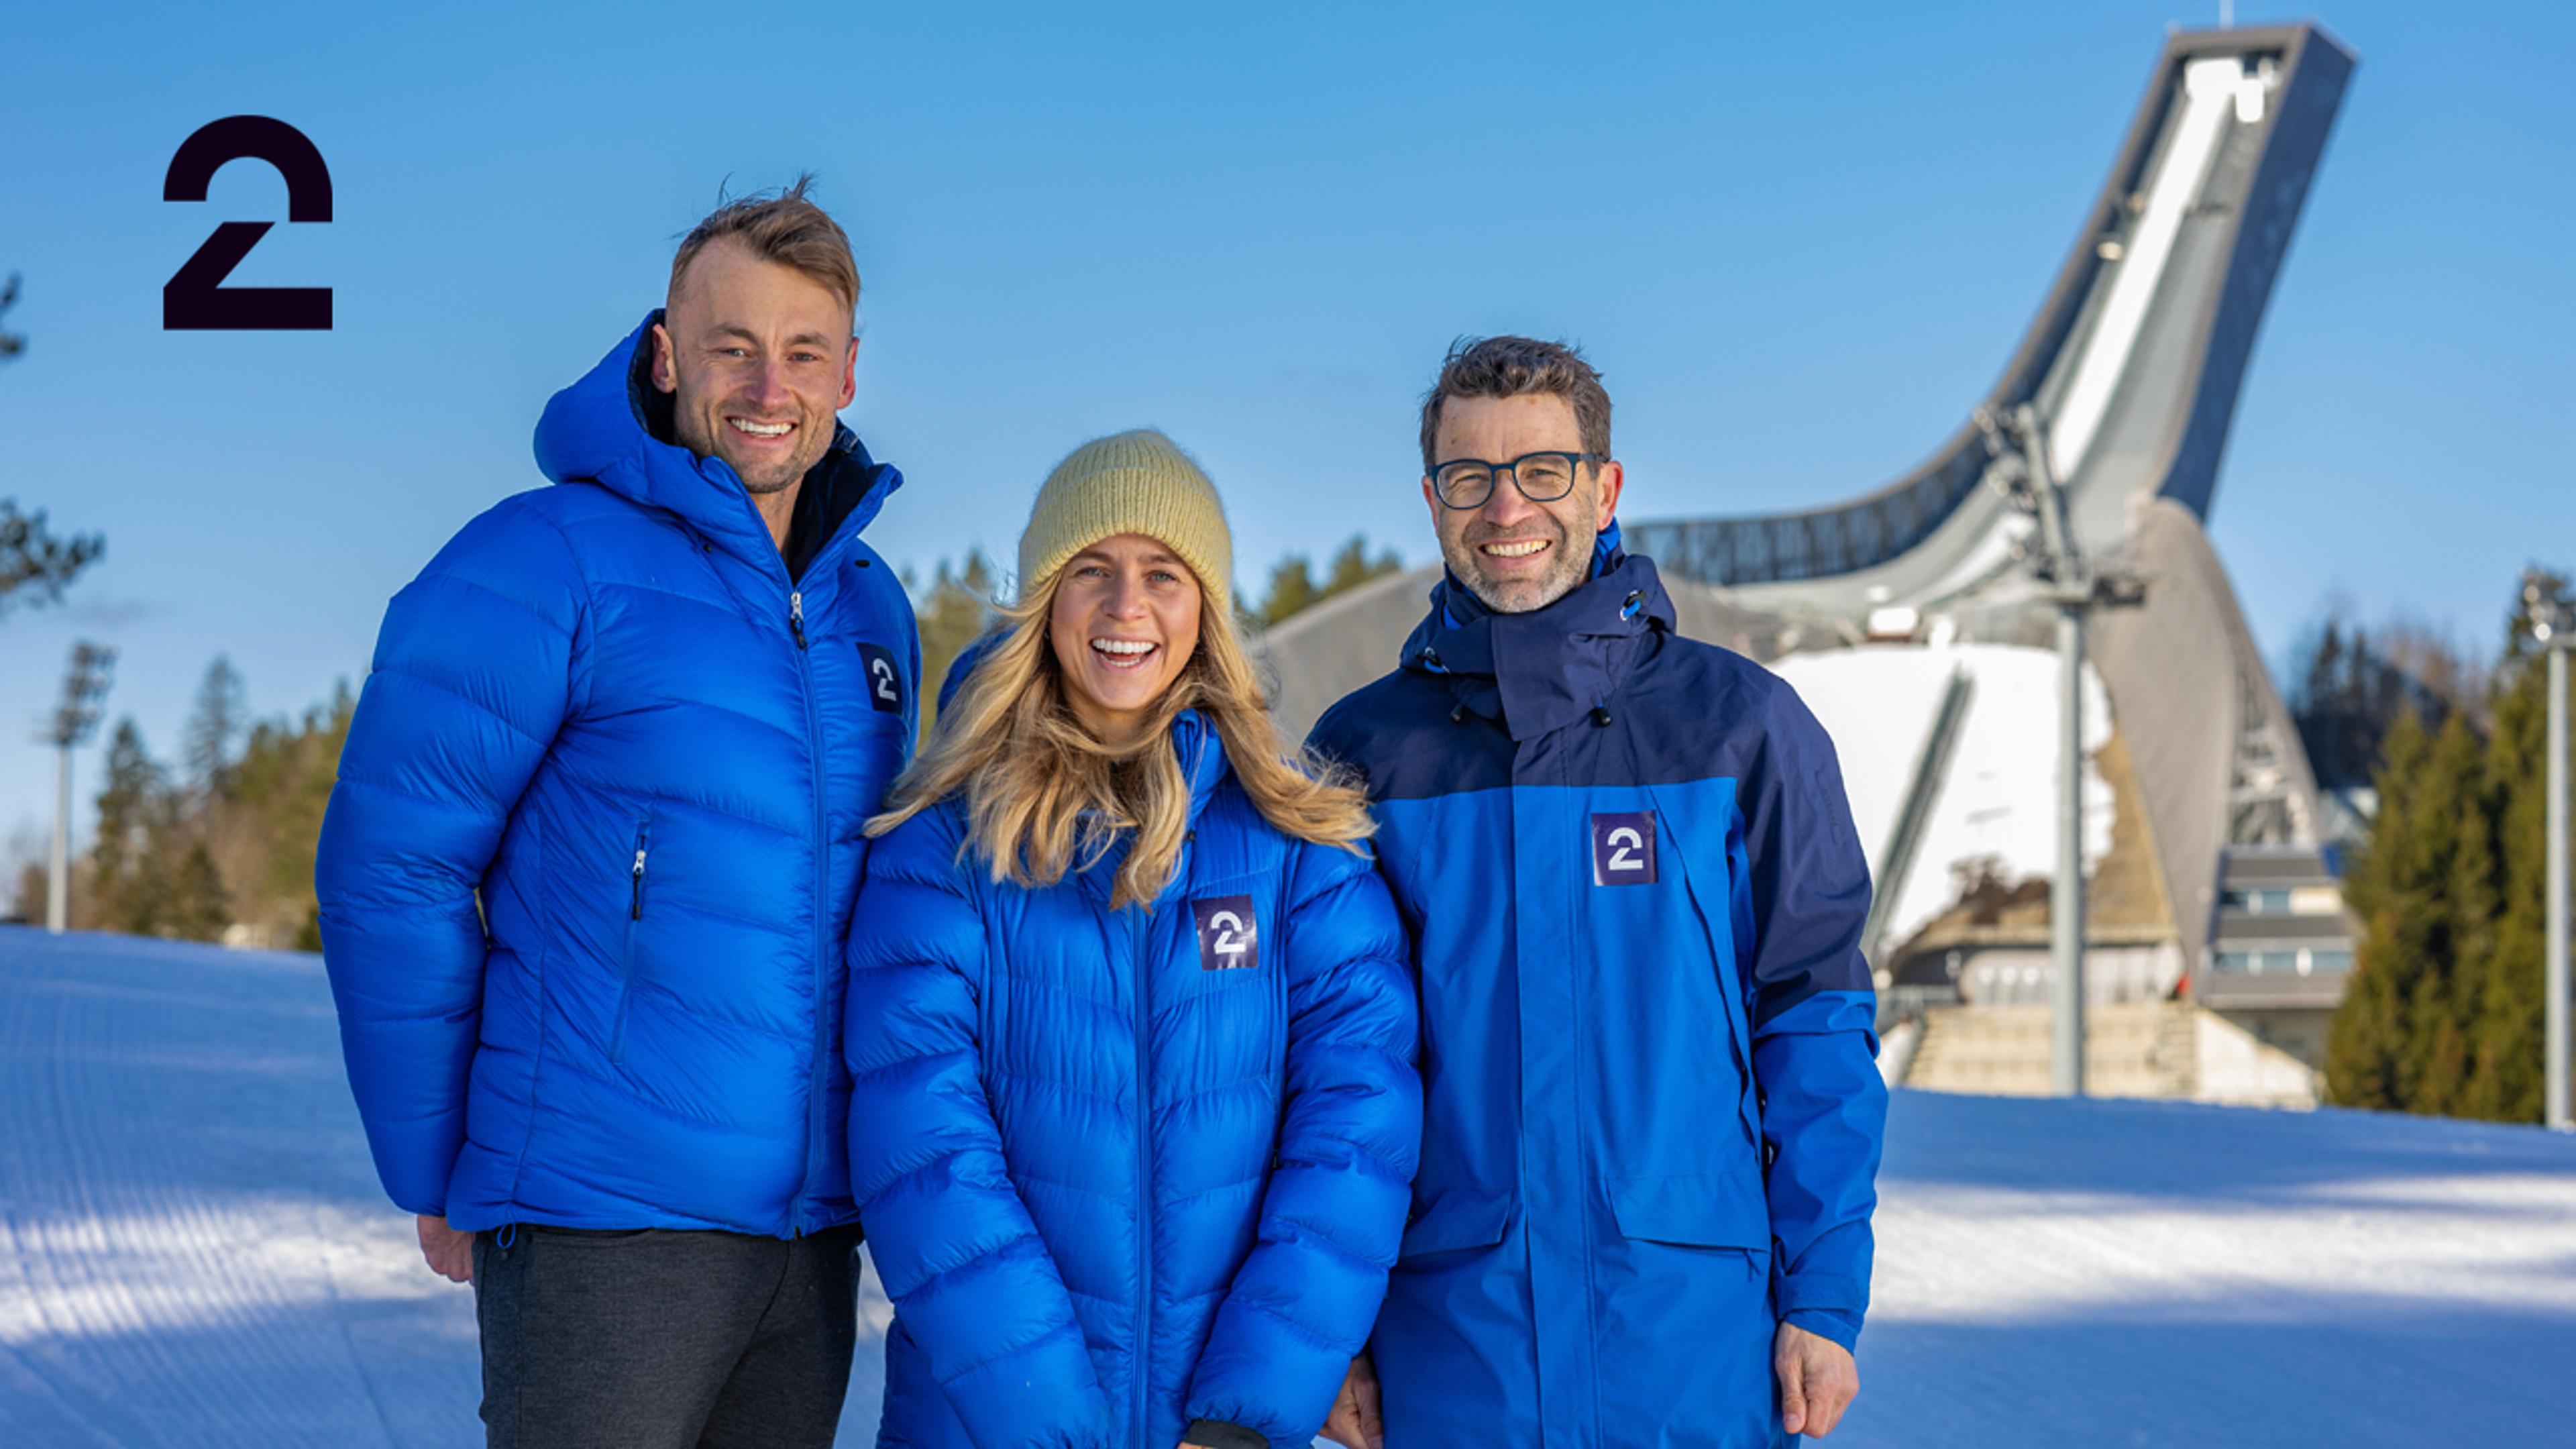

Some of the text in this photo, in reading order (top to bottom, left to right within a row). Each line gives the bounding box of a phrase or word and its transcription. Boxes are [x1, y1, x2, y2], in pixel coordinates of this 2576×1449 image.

[873, 658, 897, 700] 2
[1607, 827, 1644, 870] 2
[1210, 911, 1246, 954] 2
